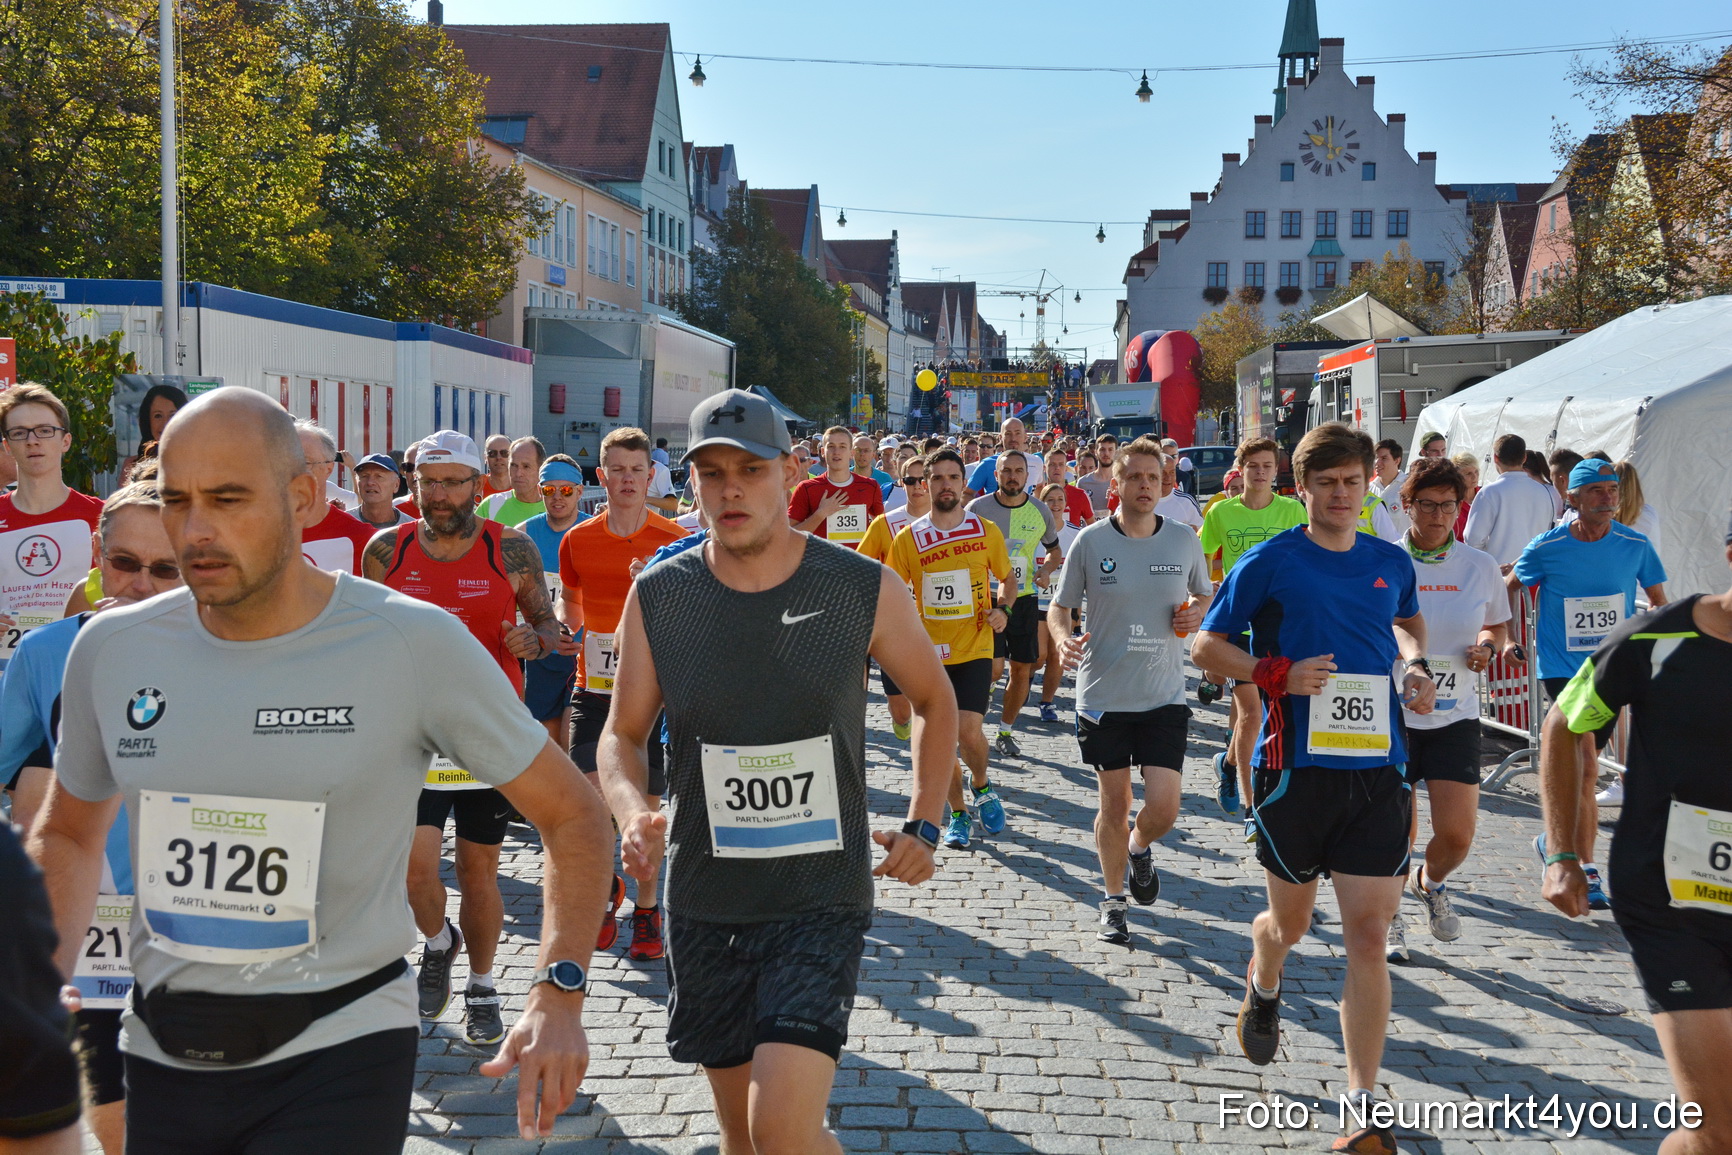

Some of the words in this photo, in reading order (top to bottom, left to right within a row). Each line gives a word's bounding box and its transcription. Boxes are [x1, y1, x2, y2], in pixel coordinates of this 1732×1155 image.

[982, 375, 1016, 384] START
[837, 515, 858, 527] 335
[920, 549, 951, 567] MAX
[953, 541, 987, 556] BÖGL
[1150, 564, 1182, 572] BOCK
[2, 585, 32, 593] LAUFEN
[33, 582, 48, 590] MIT
[51, 581, 74, 590] HERZ
[934, 585, 955, 601] 79
[1574, 610, 1617, 629] 2139
[1129, 624, 1147, 636] 19.
[1336, 680, 1371, 690] BOCK
[1331, 696, 1374, 722] 365
[255, 706, 354, 728] BOCK
[118, 738, 157, 749] PARTL
[1326, 737, 1372, 748] MARKUS
[116, 750, 156, 758] Neumarkt
[738, 752, 795, 768] BOCK
[724, 771, 814, 811] 3007
[192, 808, 267, 830] BOCK
[735, 815, 762, 823] PARTL
[763, 812, 801, 823] Neumarkt
[165, 838, 289, 896] 3126
[1691, 870, 1718, 881] PARTL
[172, 896, 207, 908] PARTL
[210, 900, 260, 913] Neumarkt
[775, 1020, 796, 1028] NIKE
[797, 1022, 818, 1032] PRO
